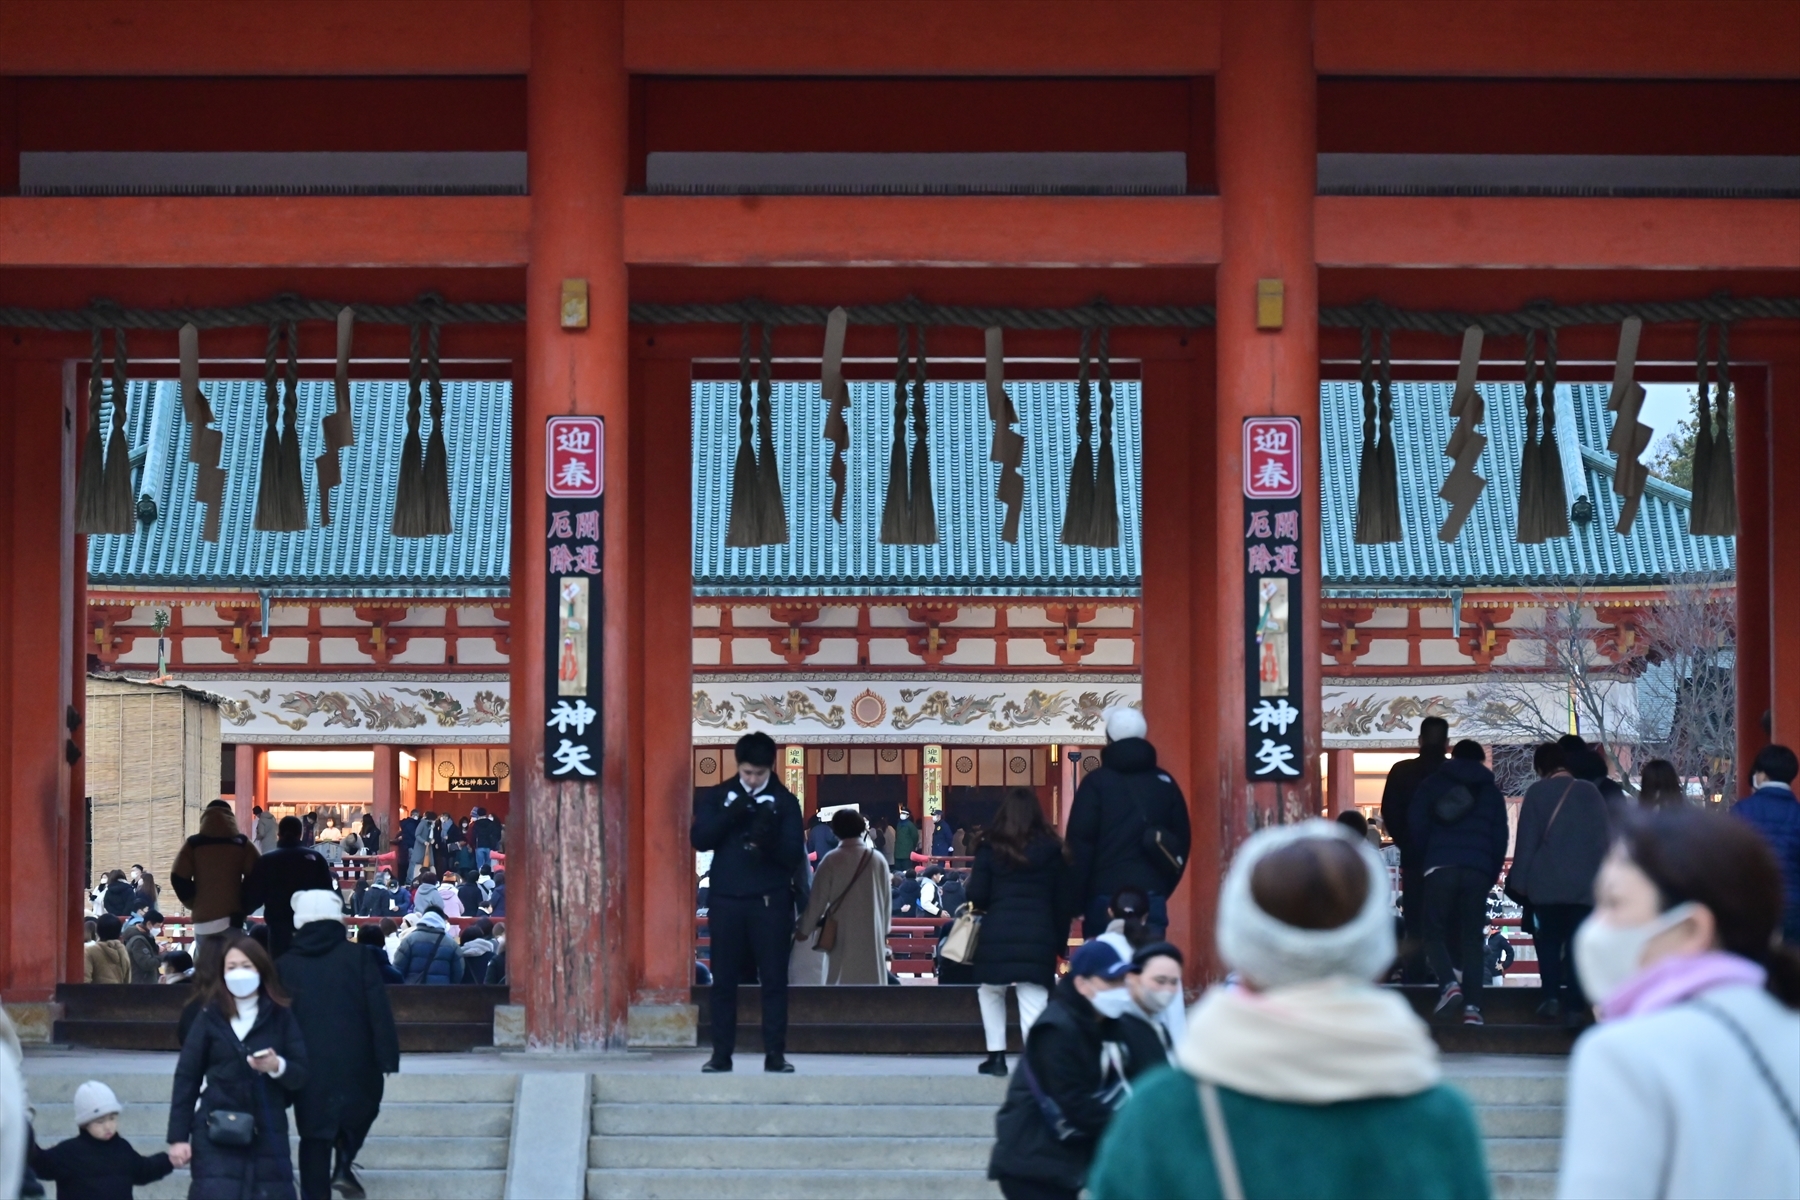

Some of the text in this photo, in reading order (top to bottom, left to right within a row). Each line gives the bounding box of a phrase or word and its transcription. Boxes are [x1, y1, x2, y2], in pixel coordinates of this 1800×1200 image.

[556, 427, 594, 488] 迎春
[1253, 427, 1292, 489] 迎春
[547, 699, 597, 776] 神矢
[1248, 699, 1300, 776] 神矢
